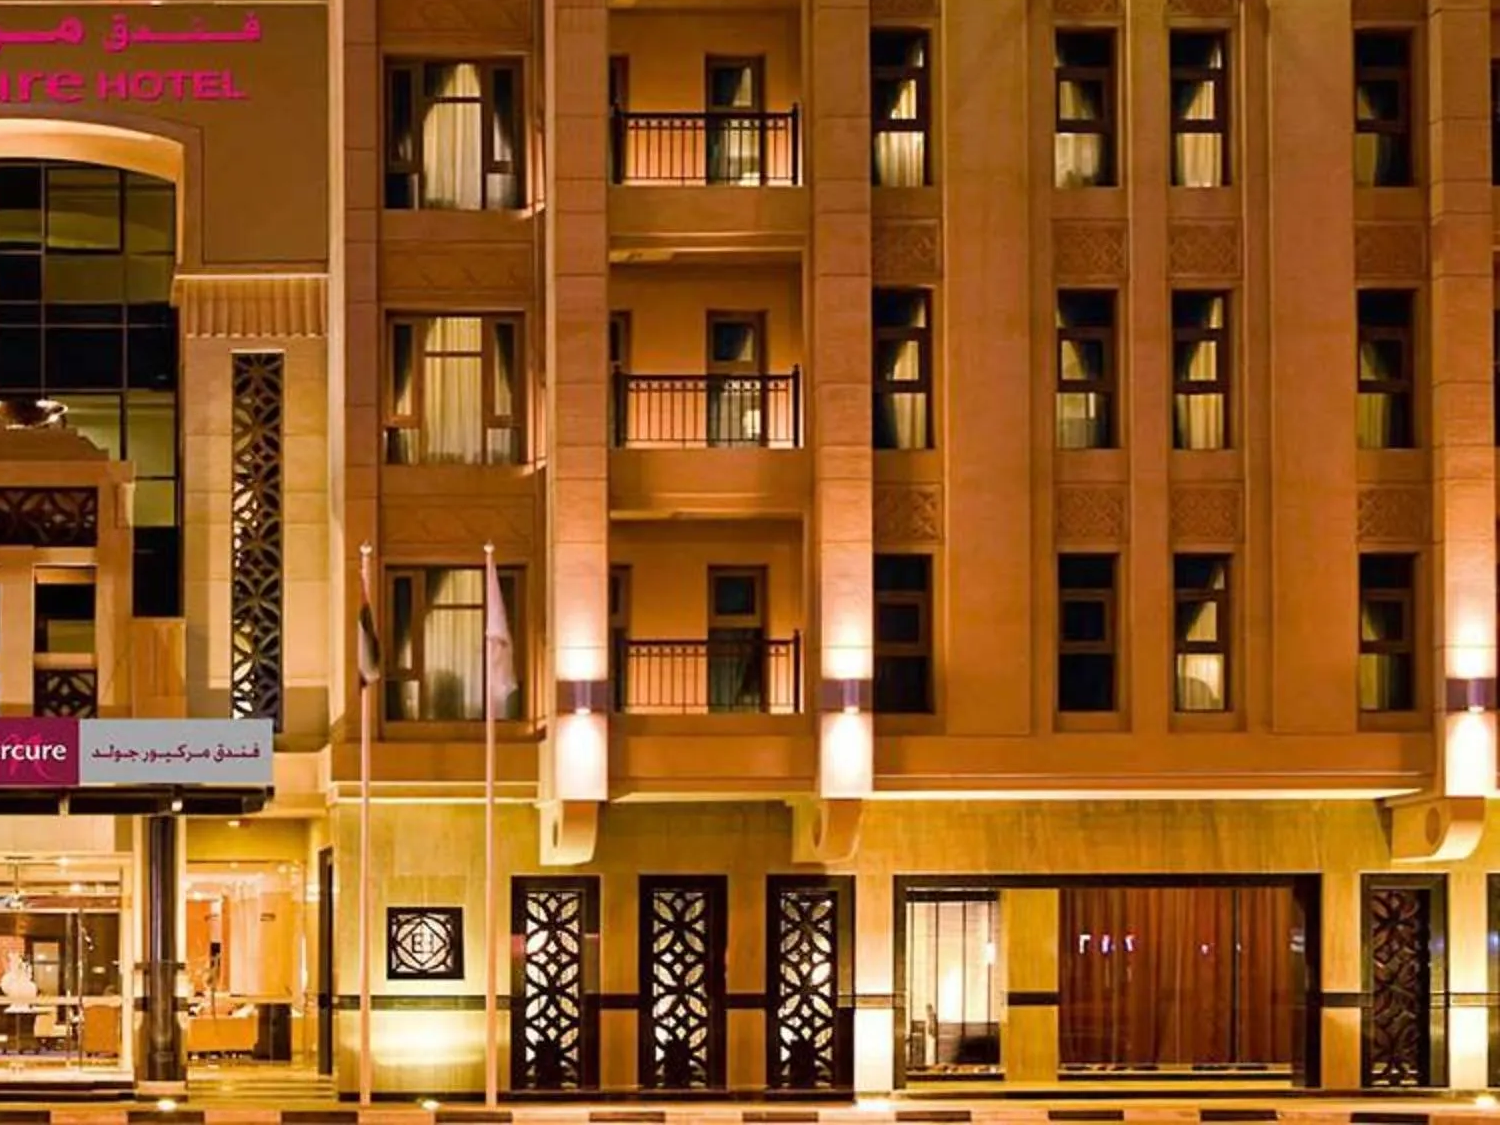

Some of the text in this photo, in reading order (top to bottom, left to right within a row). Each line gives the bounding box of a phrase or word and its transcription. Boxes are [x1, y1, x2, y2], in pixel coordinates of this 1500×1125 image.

[103, 11, 262, 53] فندق
[97, 68, 250, 102] HOTEL
[213, 742, 260, 762] فندق
